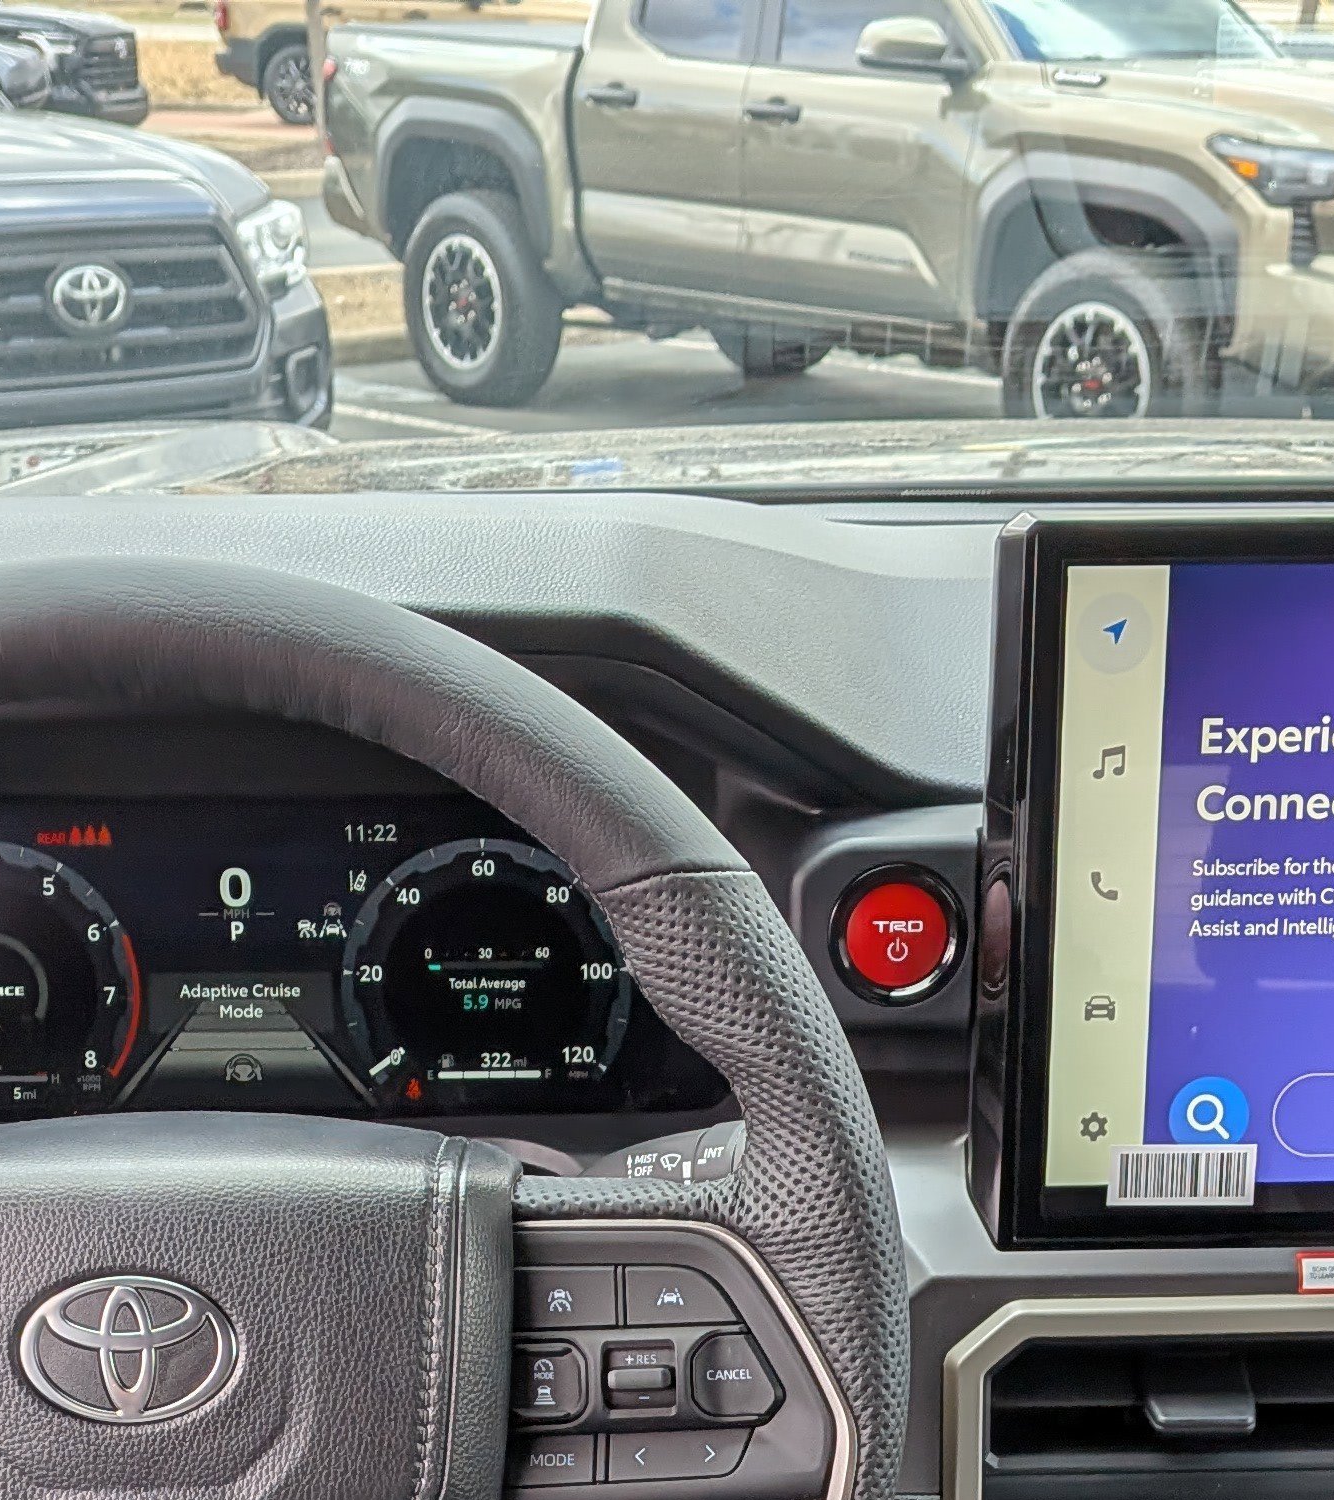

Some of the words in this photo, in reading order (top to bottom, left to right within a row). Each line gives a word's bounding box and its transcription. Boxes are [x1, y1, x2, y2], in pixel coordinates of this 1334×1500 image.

[344, 824, 397, 842] 11:22
[471, 860, 495, 876] 60
[1192, 858, 1280, 877] Subscribe
[1284, 857, 1310, 876] for
[42, 878, 55, 896] 5
[219, 867, 251, 907] 0
[546, 886, 569, 903] 80
[397, 888, 420, 905] 40
[1191, 889, 1273, 910] guidance
[1277, 888, 1316, 905] with
[87, 923, 100, 941] 6
[231, 921, 244, 941] P
[872, 920, 923, 933] TRD
[1189, 920, 1240, 937] Assist
[1244, 919, 1278, 936] and
[478, 948, 492, 959] 30
[535, 947, 549, 958] 60
[360, 965, 382, 982] 20
[580, 962, 612, 980] 100
[180, 984, 249, 1001] Adaptive
[252, 984, 300, 998] Cruise
[449, 978, 477, 989] Total
[479, 978, 526, 991] Average
[103, 986, 116, 1005] 7
[463, 994, 488, 1010] 5.9
[494, 998, 522, 1010] MPG
[219, 1005, 263, 1018] Mode
[84, 1050, 97, 1068] 8
[480, 1052, 512, 1068] 322
[562, 1046, 594, 1063] 120
[634, 1154, 657, 1165] MIST
[703, 1146, 725, 1159] INT
[634, 1166, 653, 1177] OFF
[707, 1369, 753, 1381] CANCEL
[530, 1453, 575, 1467] MODE
